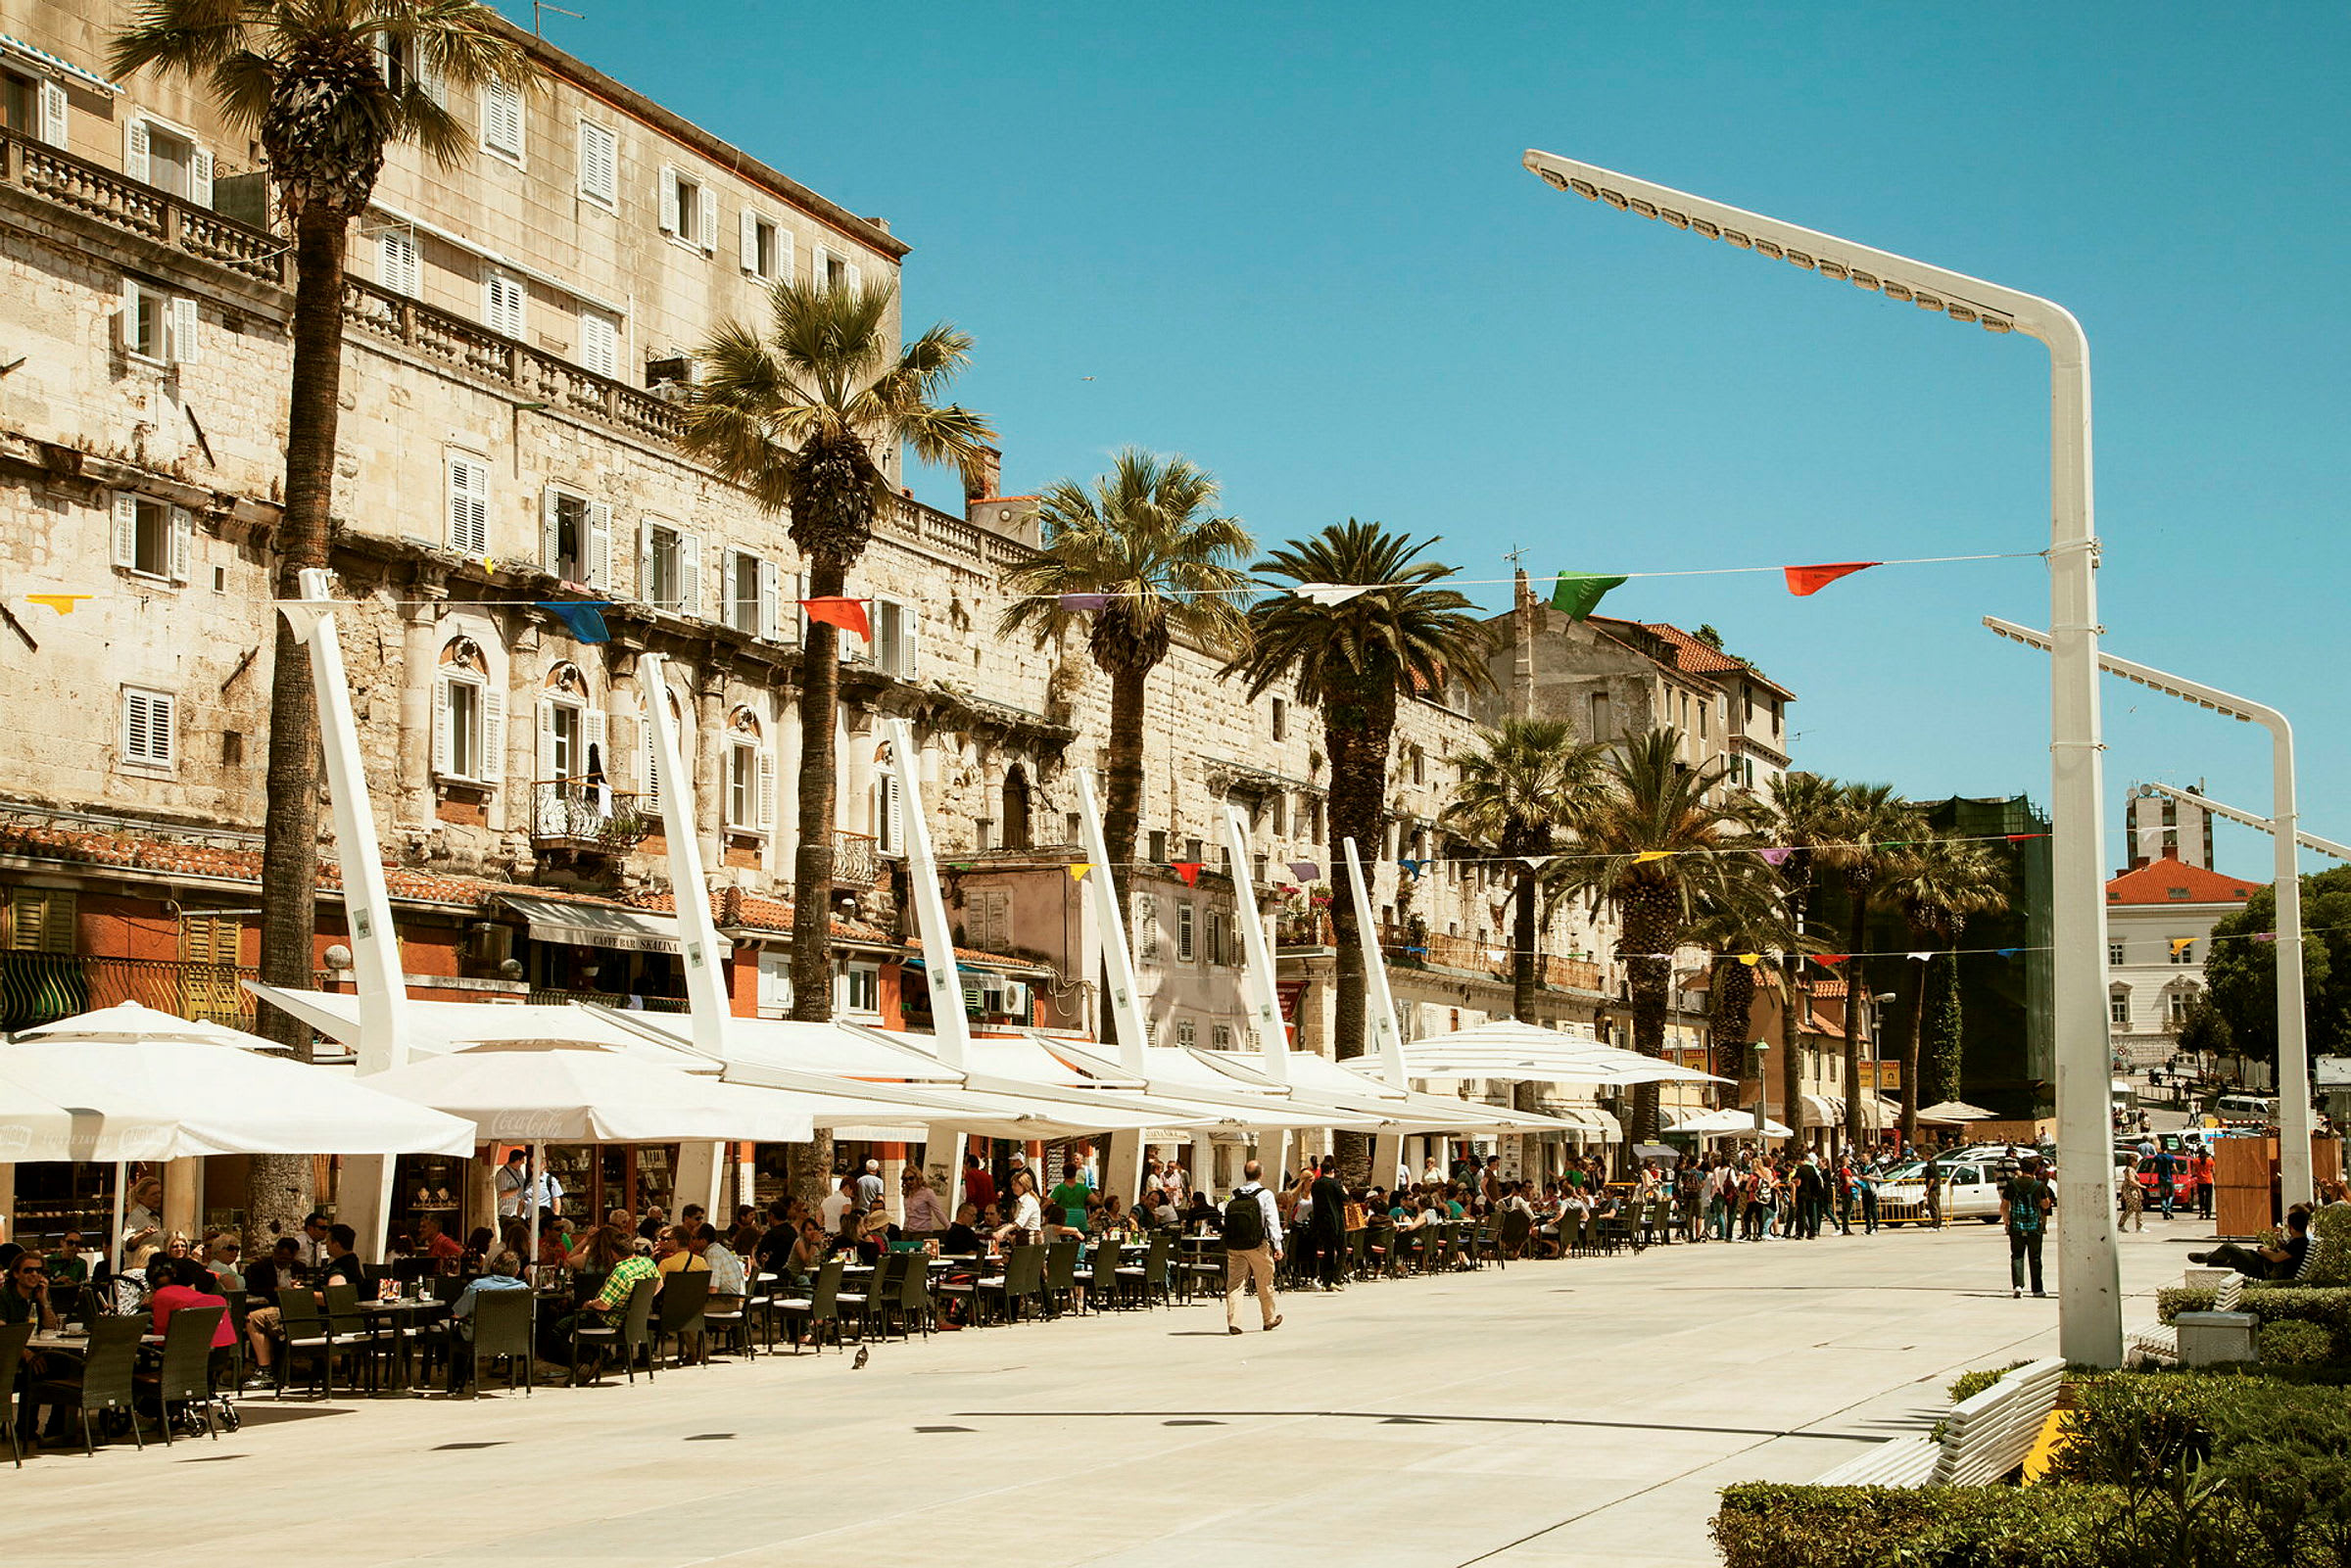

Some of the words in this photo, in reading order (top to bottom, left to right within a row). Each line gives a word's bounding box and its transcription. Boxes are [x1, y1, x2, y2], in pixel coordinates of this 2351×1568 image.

[594, 936, 618, 947] CAFFE
[619, 938, 636, 949] BAR
[640, 939, 677, 952] SKALINA
